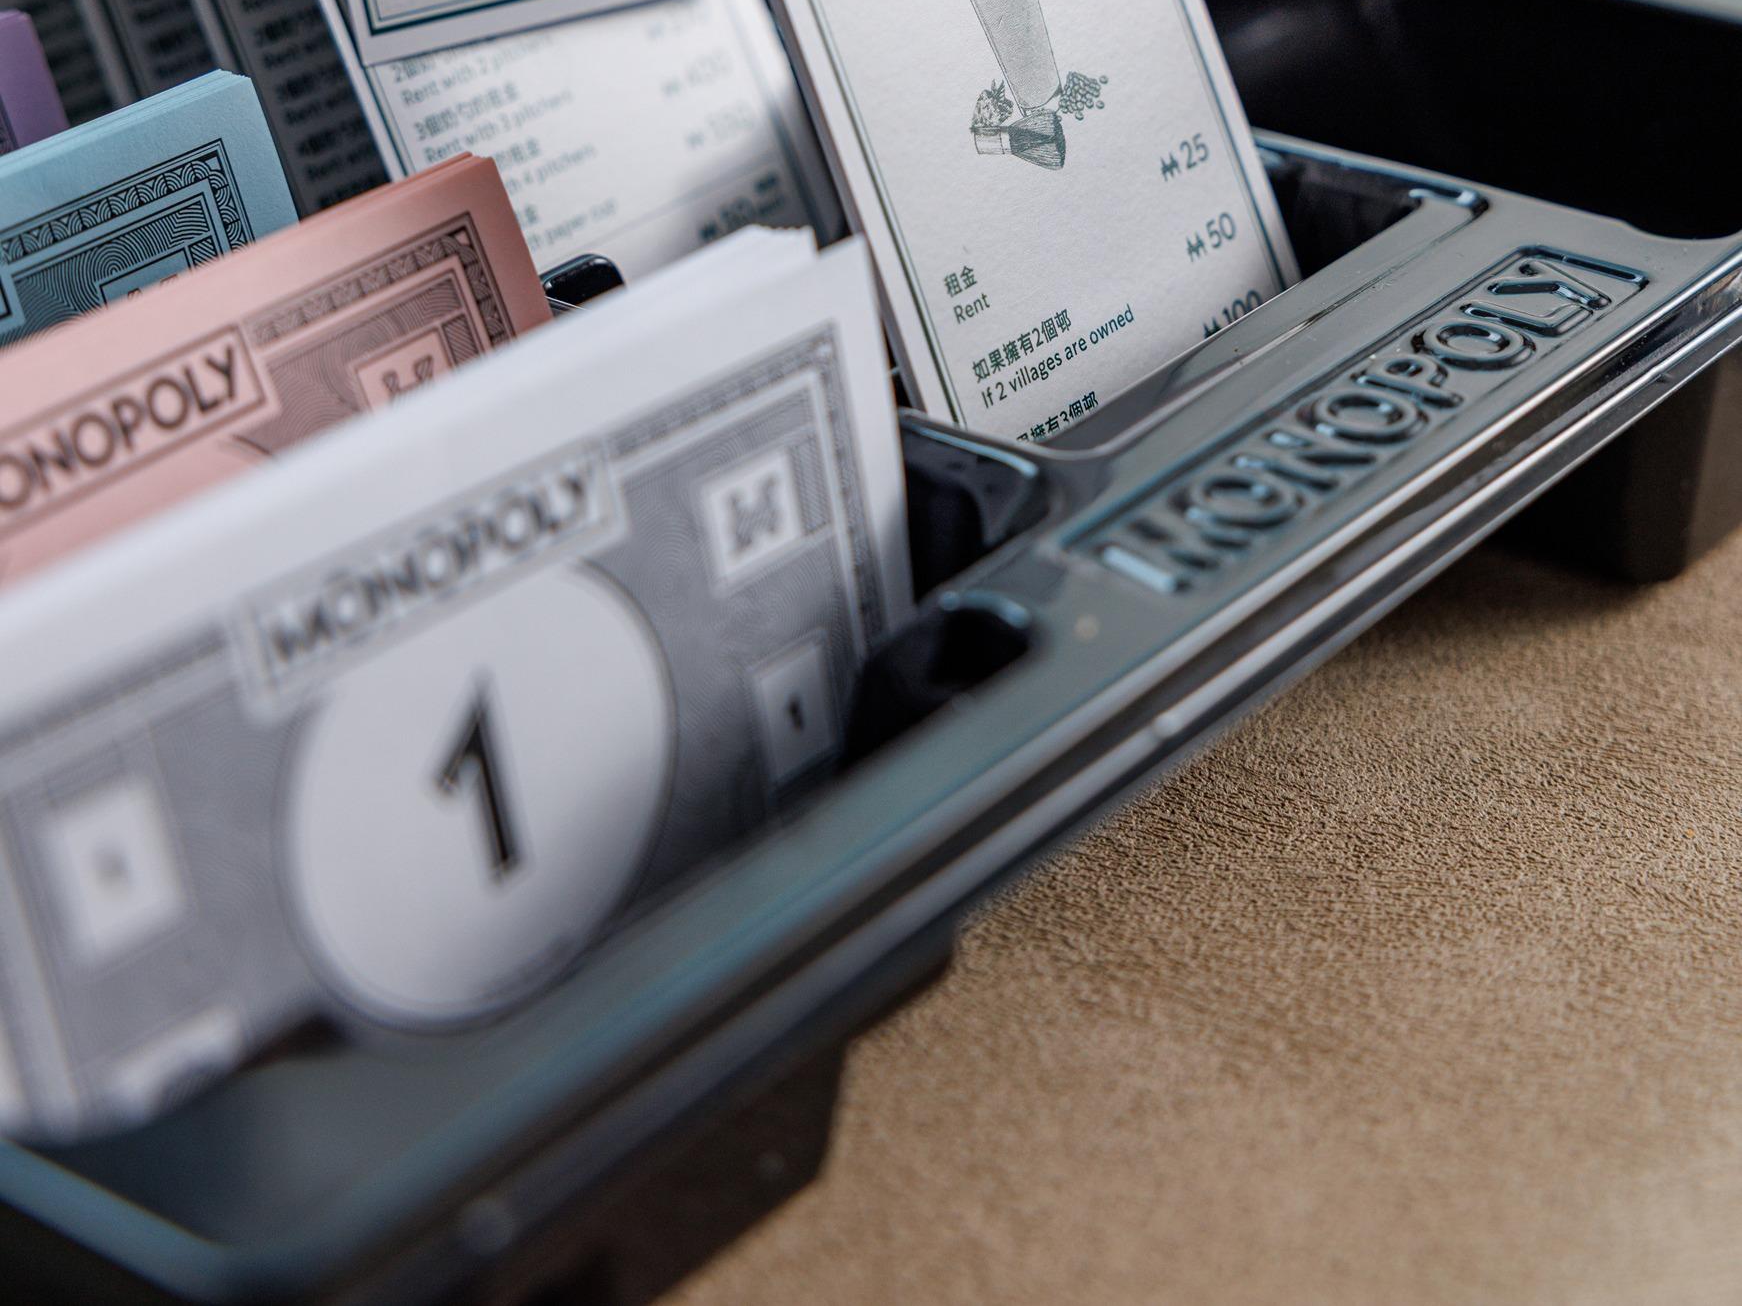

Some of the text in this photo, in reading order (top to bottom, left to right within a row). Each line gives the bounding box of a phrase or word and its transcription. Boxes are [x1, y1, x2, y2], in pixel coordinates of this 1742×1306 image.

[402, 79, 440, 107] Rent
[943, 265, 979, 298] 租金
[953, 293, 991, 325] Rent
[971, 308, 1073, 384] 如果擁有2個邨
[980, 303, 1136, 410] If 2 villages are owned
[0, 340, 241, 514] ONOPOLY
[1102, 256, 1614, 597] MONOPOLY
[264, 467, 594, 668] MONOPOLY
[433, 675, 522, 886] 1
